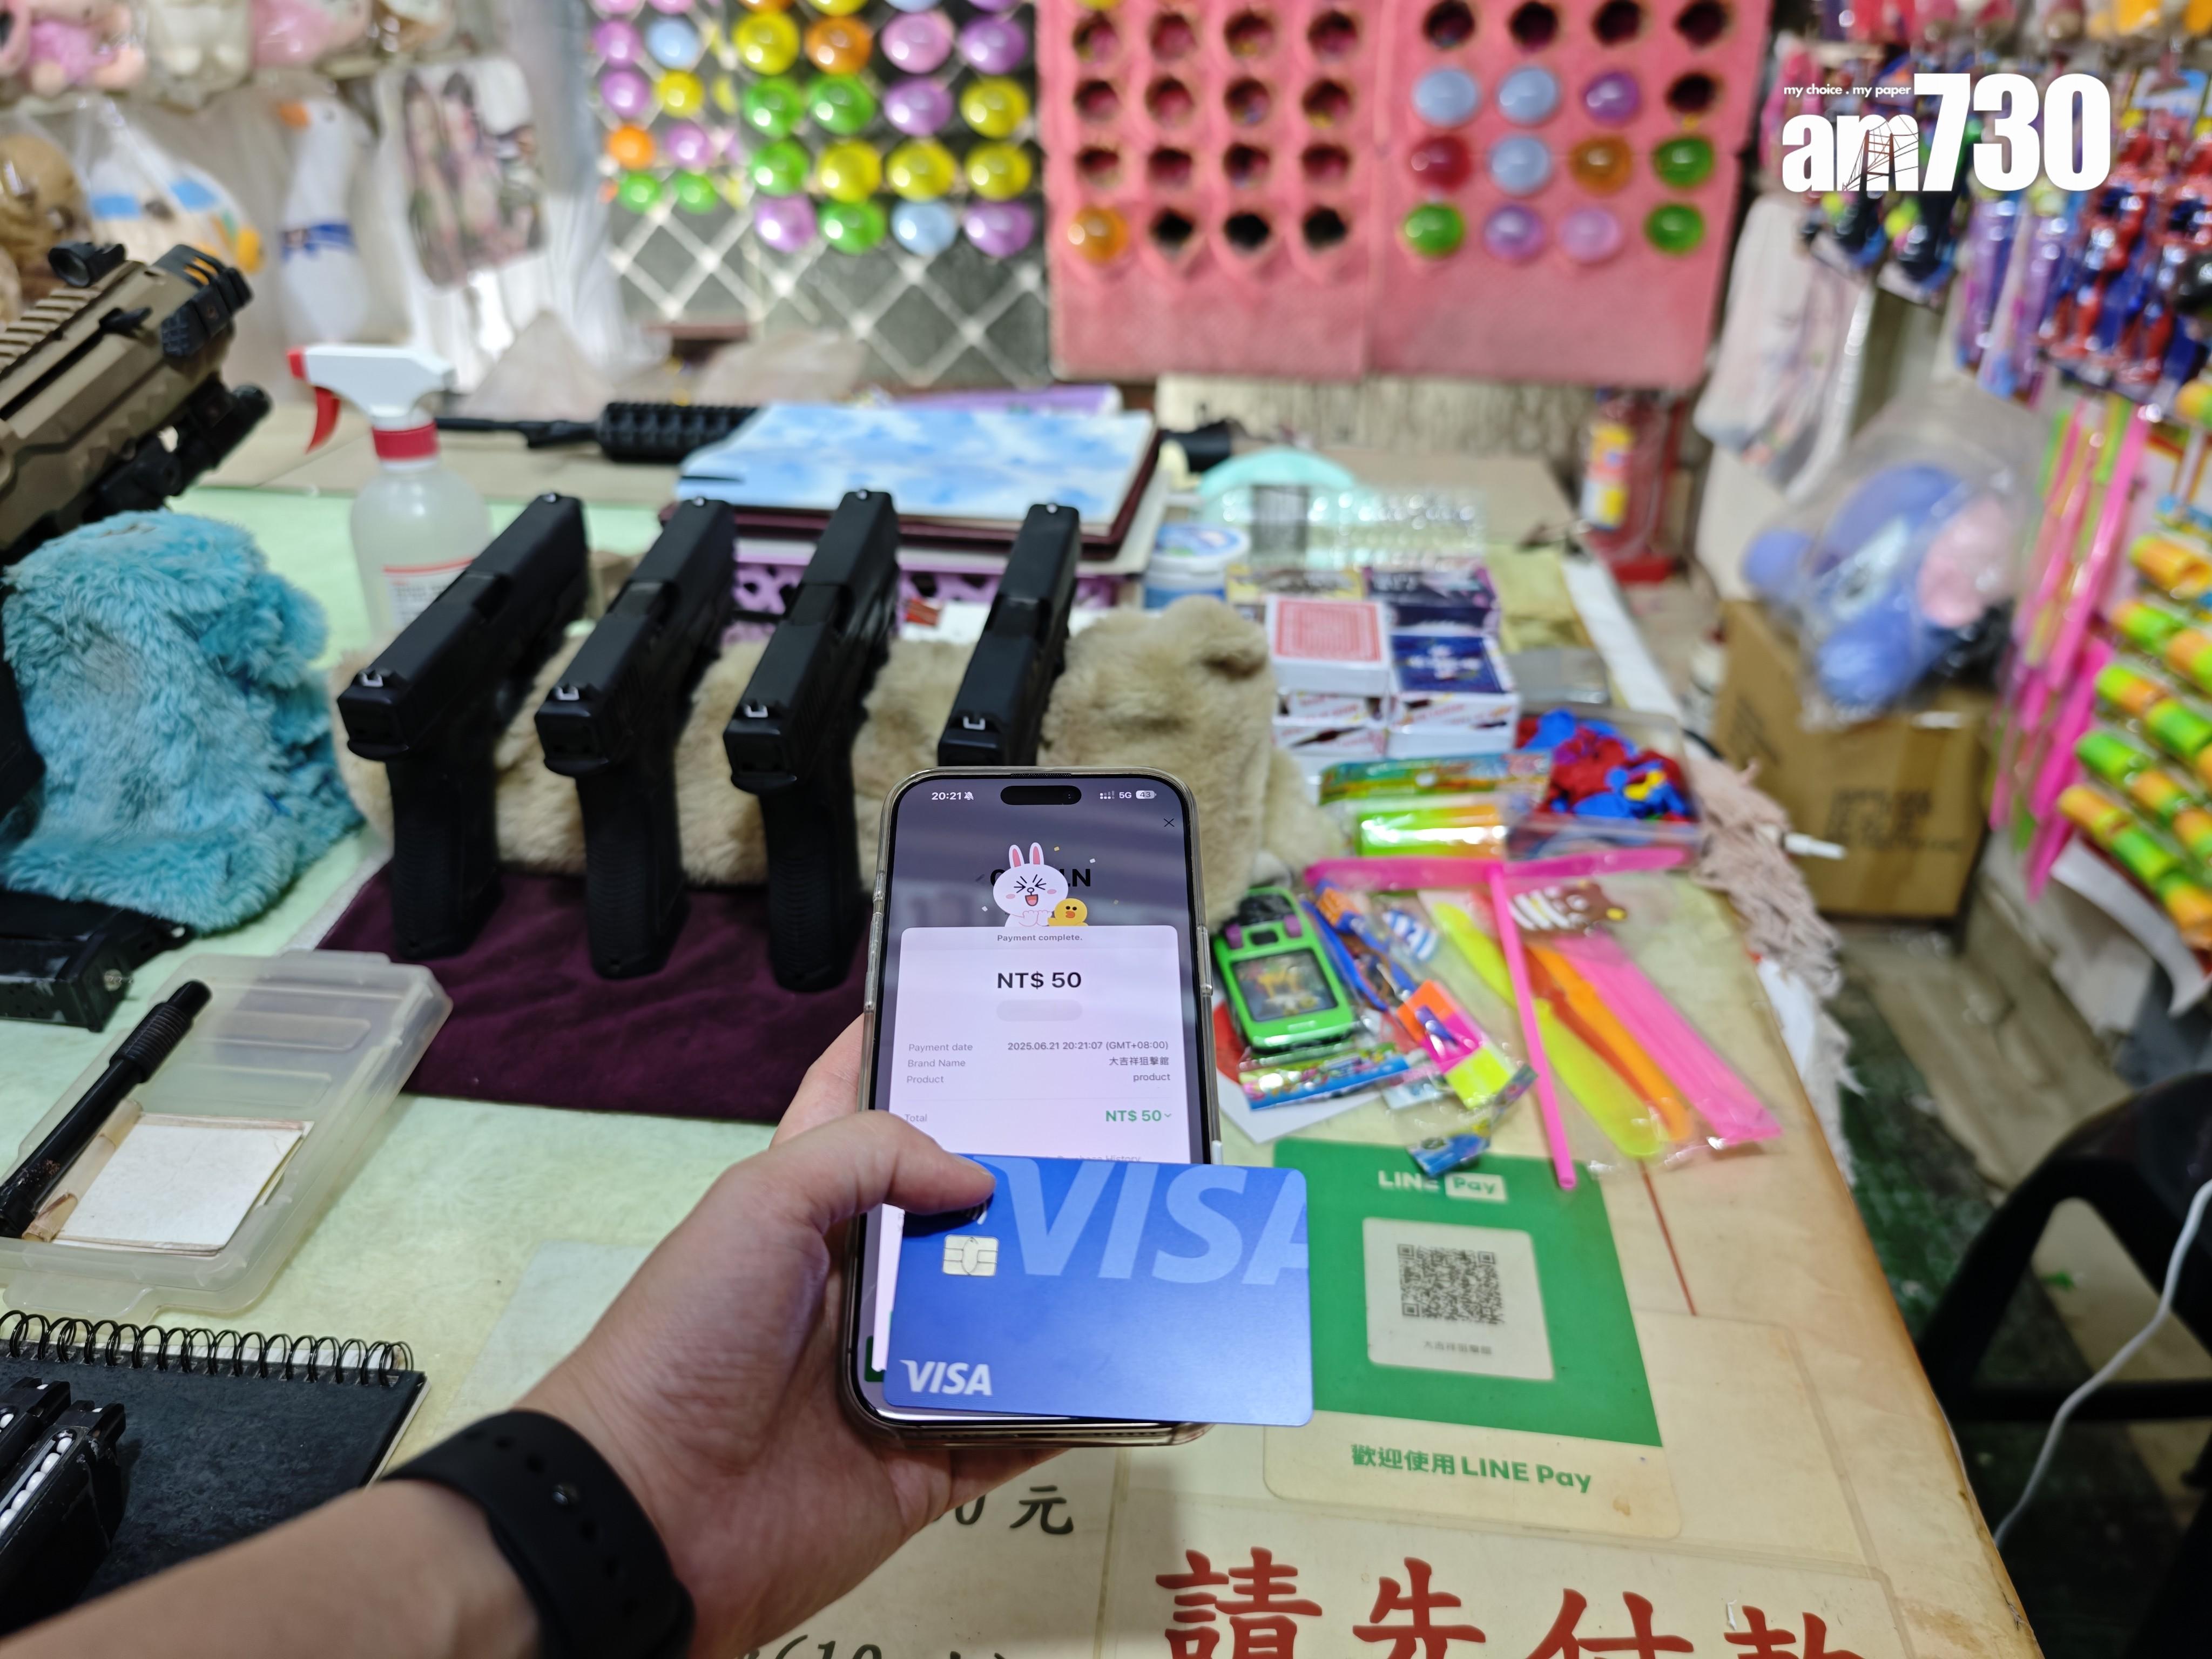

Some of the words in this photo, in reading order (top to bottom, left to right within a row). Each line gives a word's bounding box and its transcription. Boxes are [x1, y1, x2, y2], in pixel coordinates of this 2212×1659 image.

[997, 971, 1044, 989] NT$
[1051, 972, 1082, 988] 50
[908, 1043, 949, 1053] Payment
[1008, 1042, 1060, 1050] 2025.06.21
[1062, 1041, 1103, 1050] 20:21:07
[1106, 1041, 1169, 1050] (GMT+08:00)
[907, 1059, 935, 1067] Brand
[939, 1059, 966, 1067] Name
[1109, 1056, 1169, 1066] 大吉祥狙擊館
[907, 1075, 944, 1083] Product
[1133, 1073, 1170, 1082] product
[905, 1114, 927, 1122] Total
[1105, 1110, 1137, 1122] NT$
[1142, 1110, 1161, 1122] 50
[1452, 1176, 1496, 1195] Pay
[972, 1155, 1309, 1285] VISA
[899, 1359, 993, 1395] VISA
[1351, 1444, 1456, 1475] 歡迎使用
[1461, 1455, 1529, 1482] LINE
[1536, 1463, 1591, 1493] Pay
